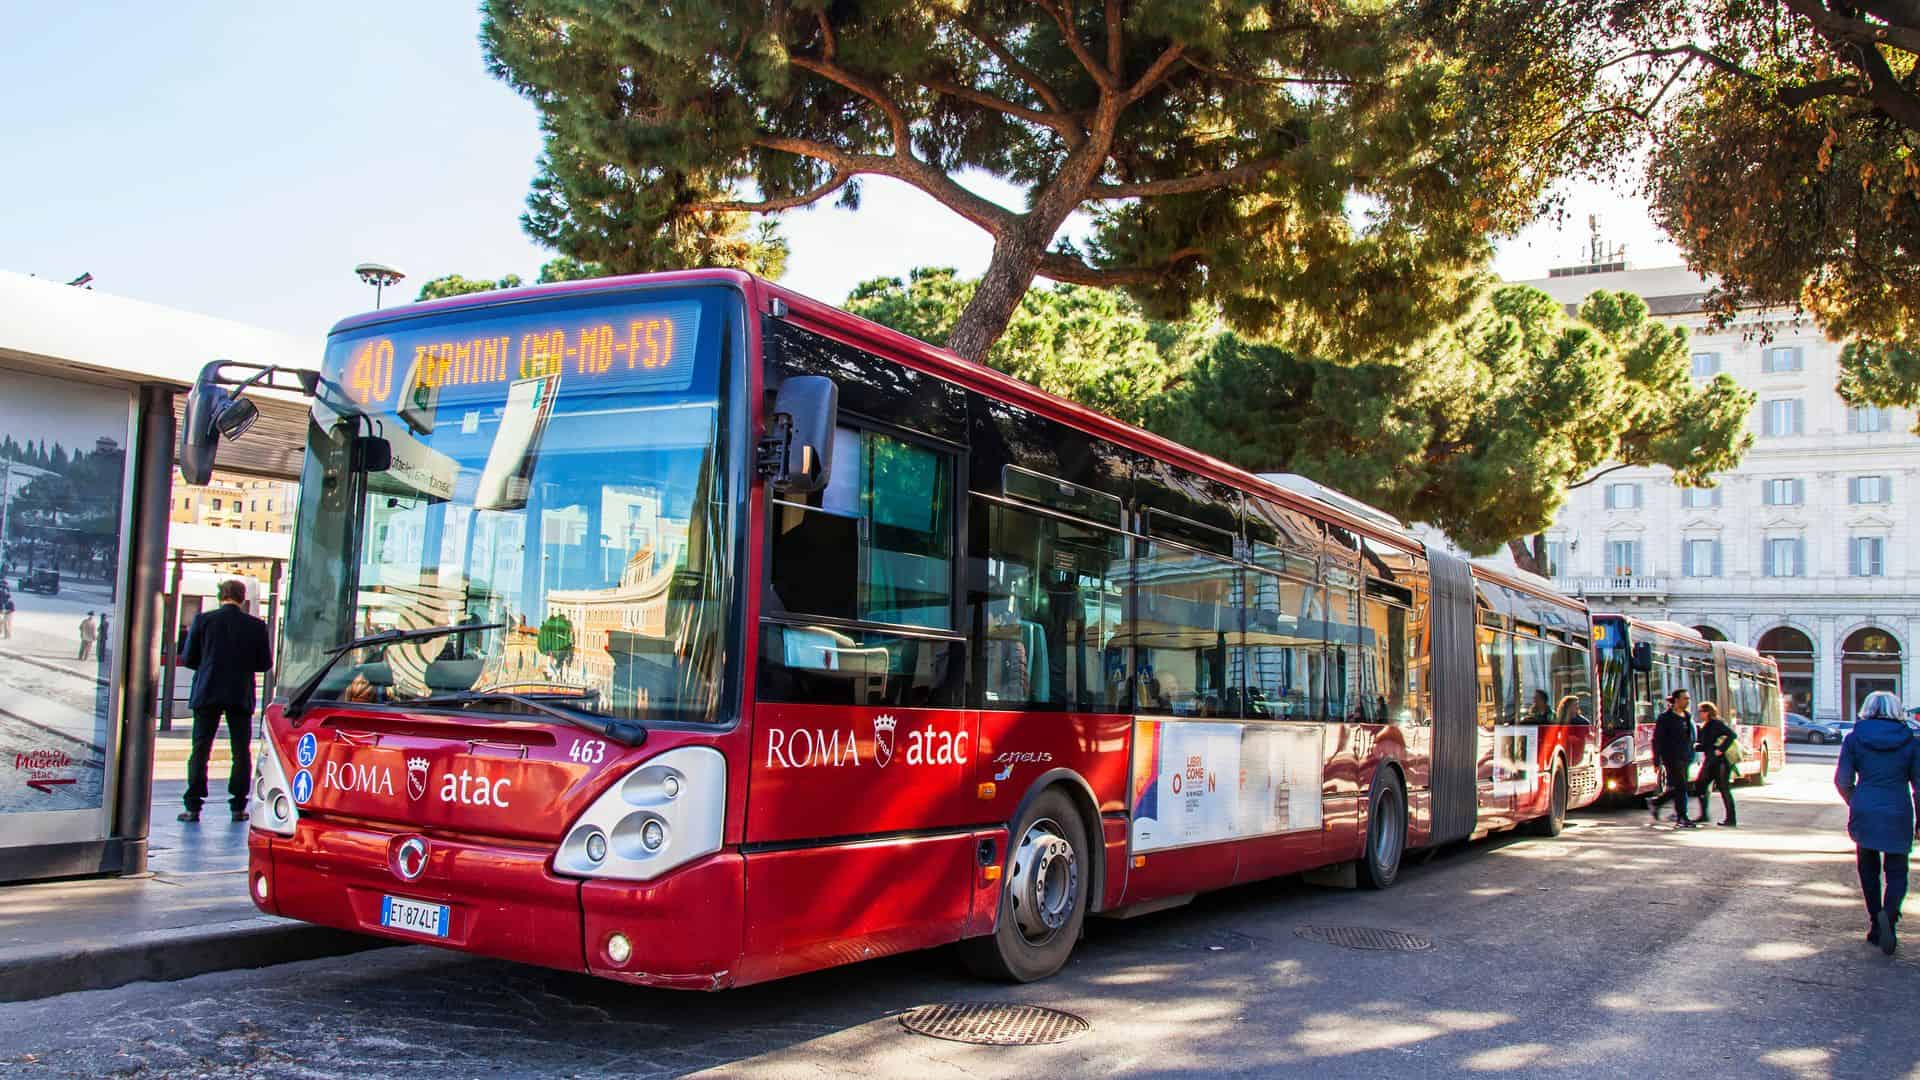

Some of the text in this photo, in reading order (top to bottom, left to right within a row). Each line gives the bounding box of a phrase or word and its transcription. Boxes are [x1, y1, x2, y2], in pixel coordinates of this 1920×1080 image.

[352, 319, 673, 403] 40 TERMINI (MA-MB-FS)
[32, 750, 61, 758] POLO
[568, 739, 606, 764] 463
[765, 723, 969, 768] ROMA atac
[15, 752, 72, 769] Museale
[992, 751, 1054, 763] CITELIS
[324, 760, 394, 796] ROMA
[440, 769, 512, 807] atac
[1185, 768, 1204, 780] COME
